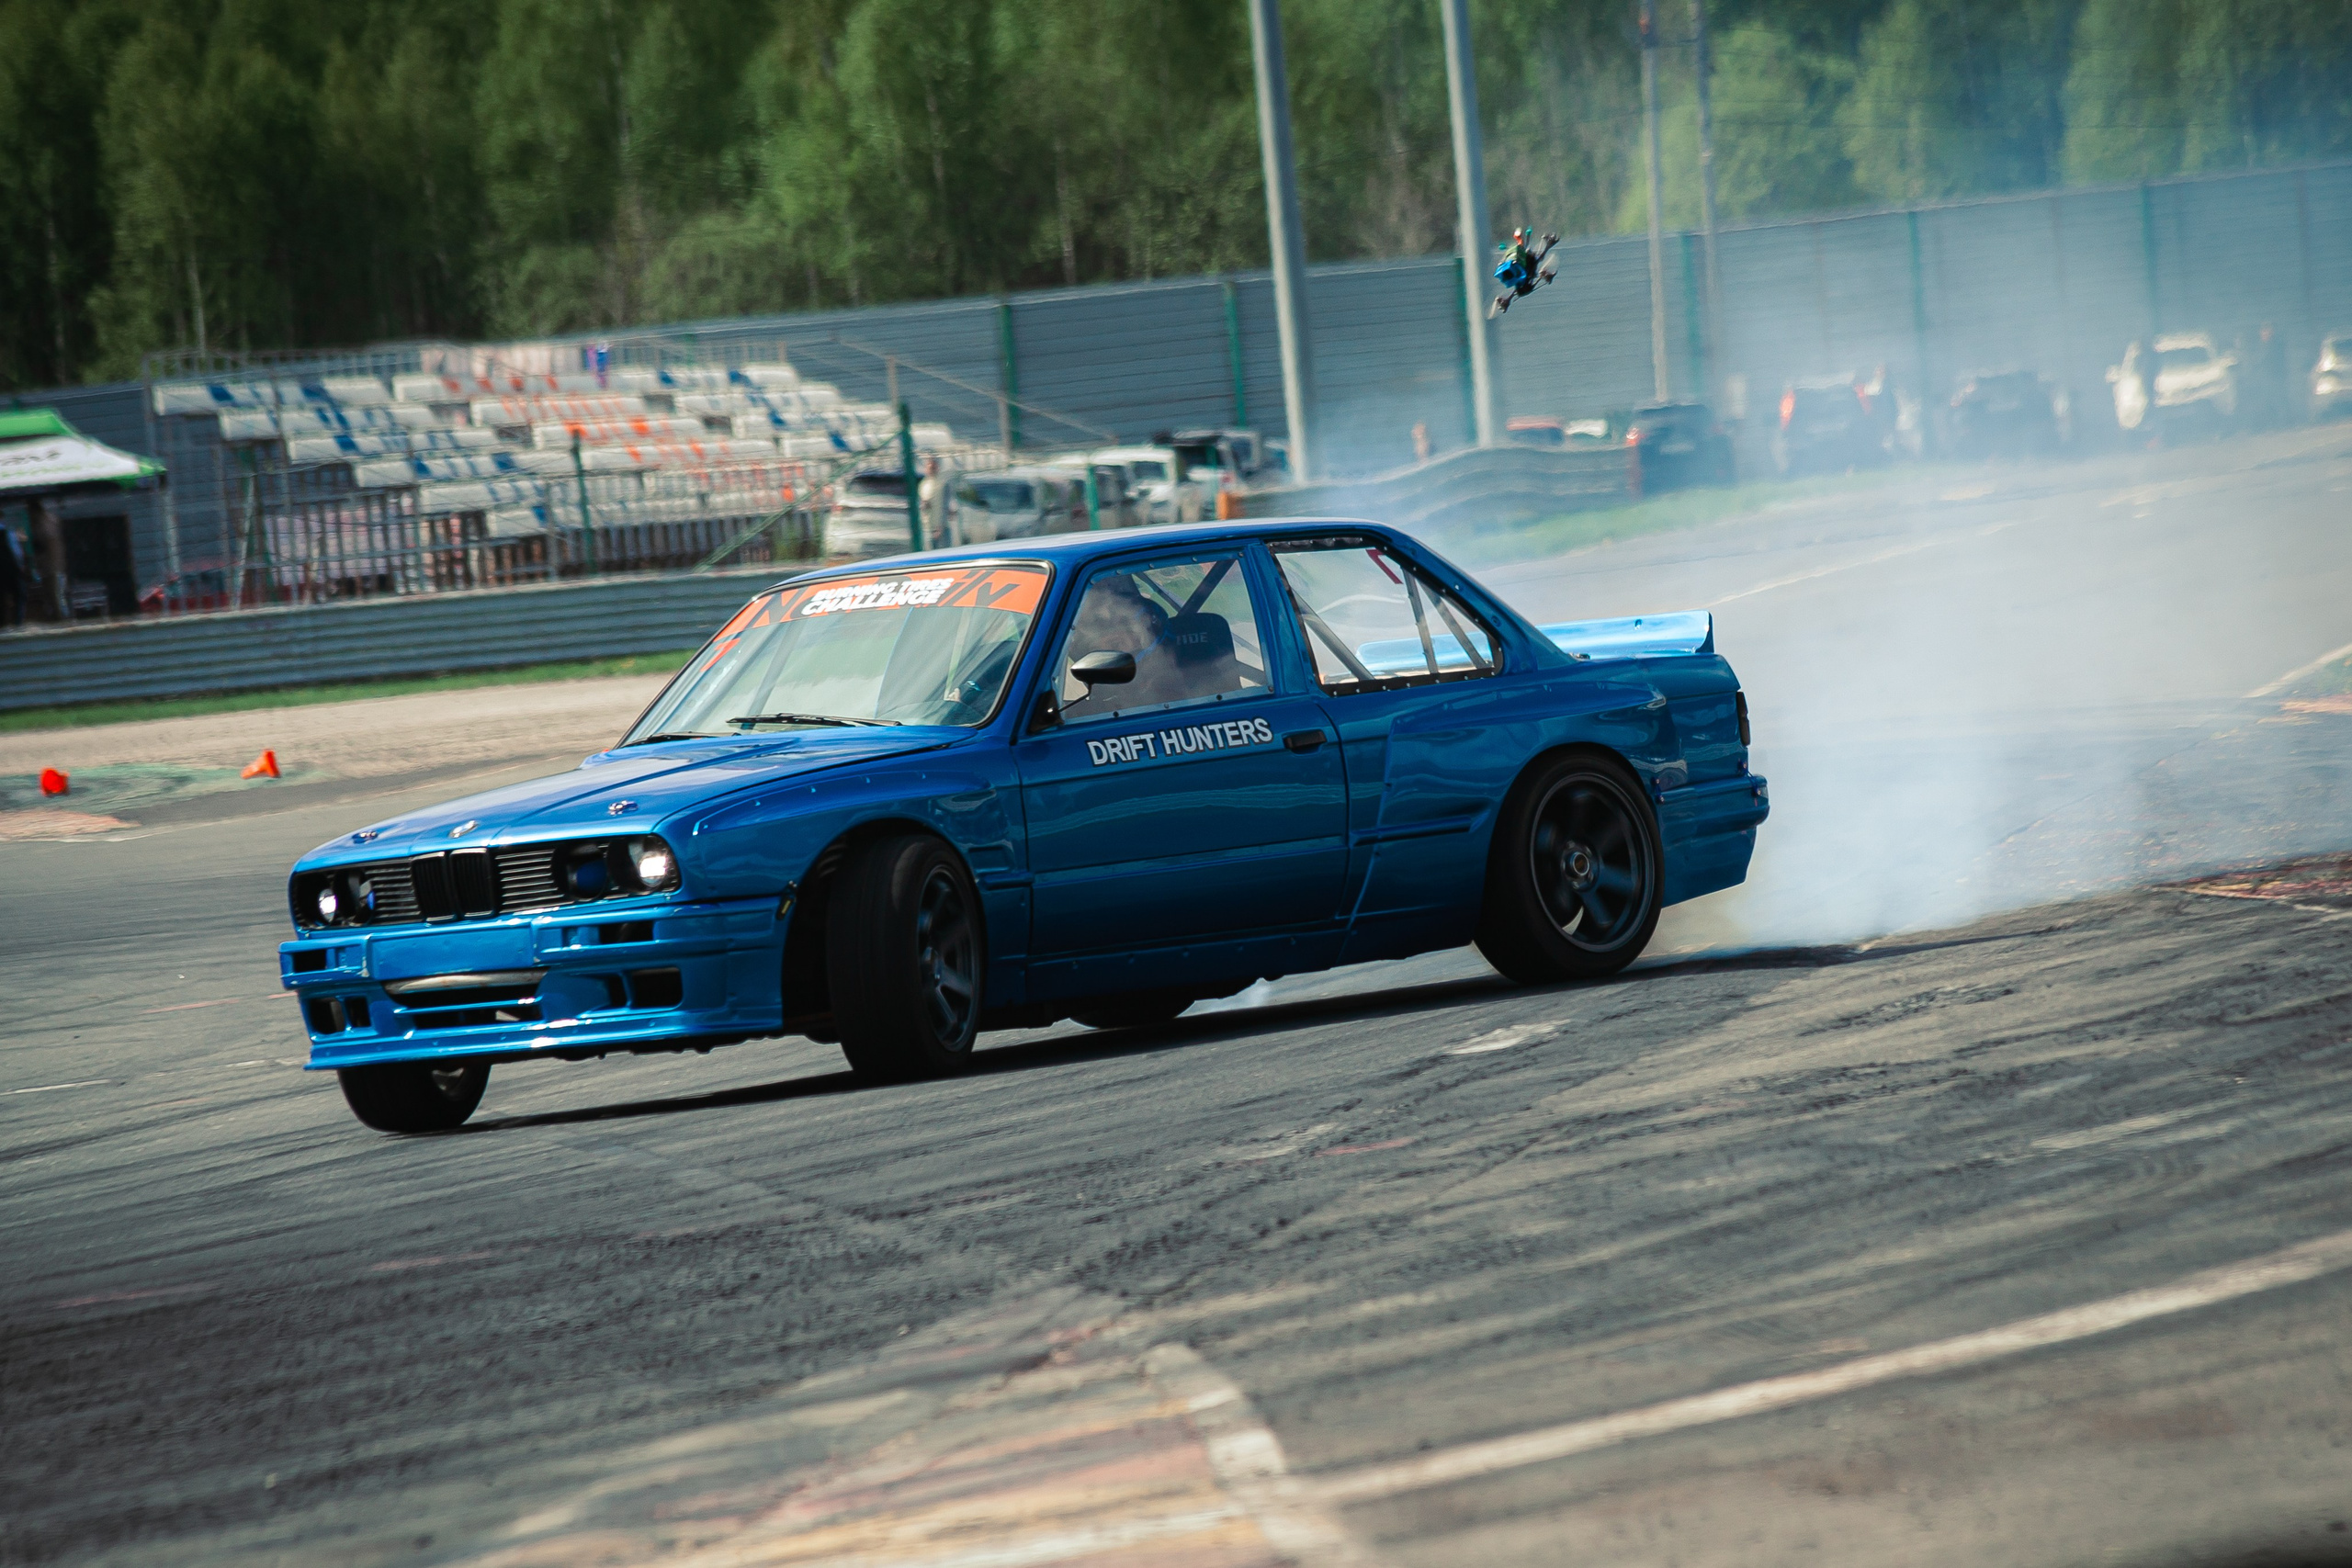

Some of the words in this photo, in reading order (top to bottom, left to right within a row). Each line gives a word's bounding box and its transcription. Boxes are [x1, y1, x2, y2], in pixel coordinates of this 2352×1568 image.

[801, 590, 945, 615] CHALLENGE
[811, 581, 899, 602] BURNING
[899, 578, 955, 594] TIRES
[1087, 733, 1157, 765] DRIFT
[1159, 717, 1273, 755] HUNTERS
